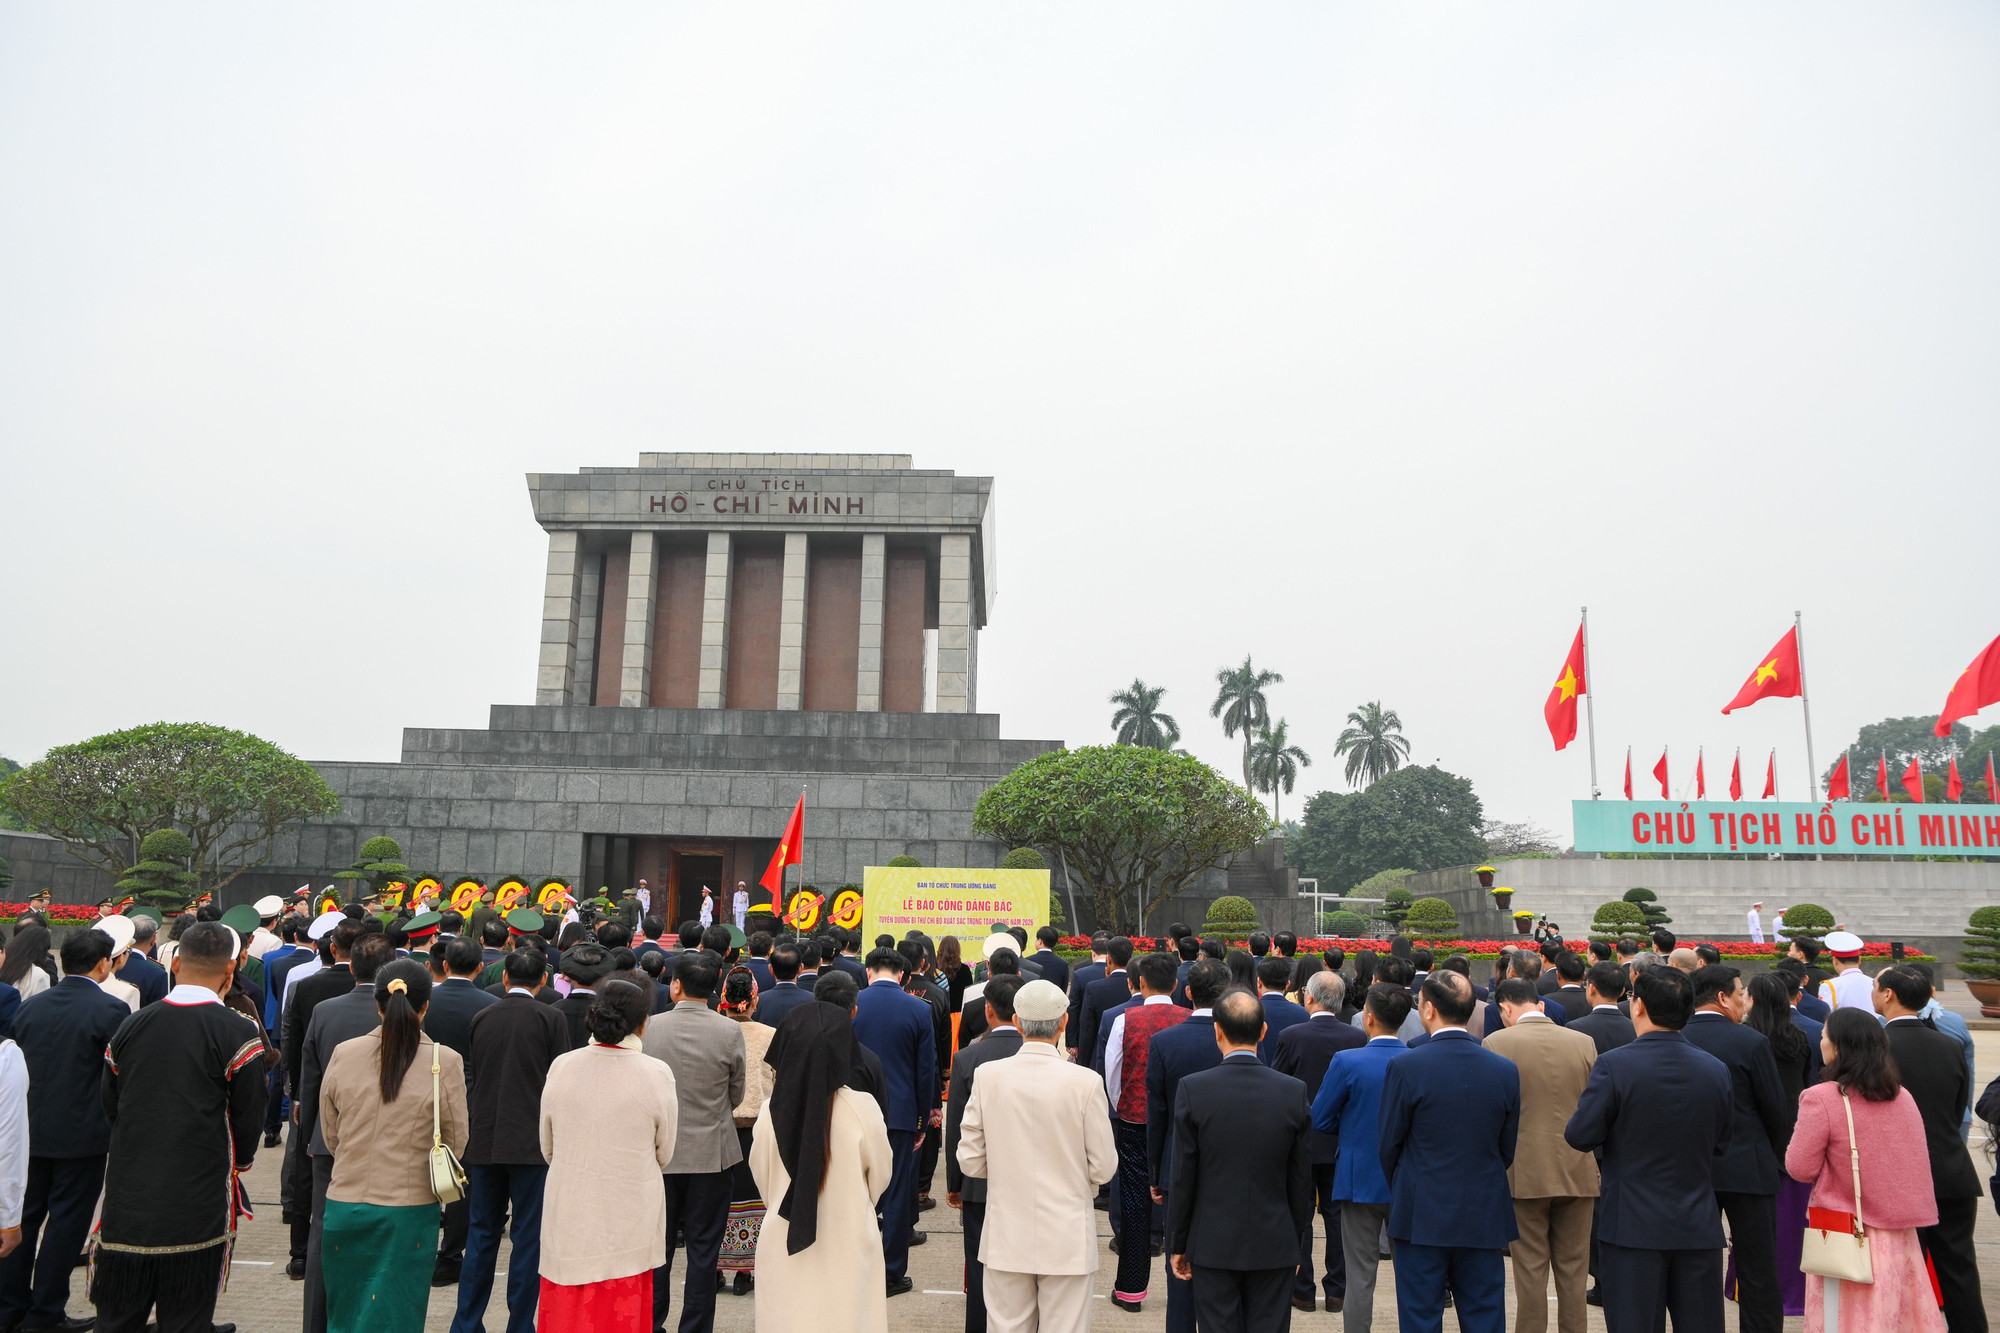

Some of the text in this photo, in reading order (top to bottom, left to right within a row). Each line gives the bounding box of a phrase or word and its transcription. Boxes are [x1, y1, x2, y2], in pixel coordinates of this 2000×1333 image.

[707, 475, 746, 490] CHỦ
[650, 491, 689, 514] HỒ
[713, 491, 762, 514] CHÍ
[1632, 802, 2000, 851] CHỦ TỊCH HỒ CHÍ MINH
[903, 895, 1013, 912] LỄ BÁO CÔNG DÂNG BÁC
